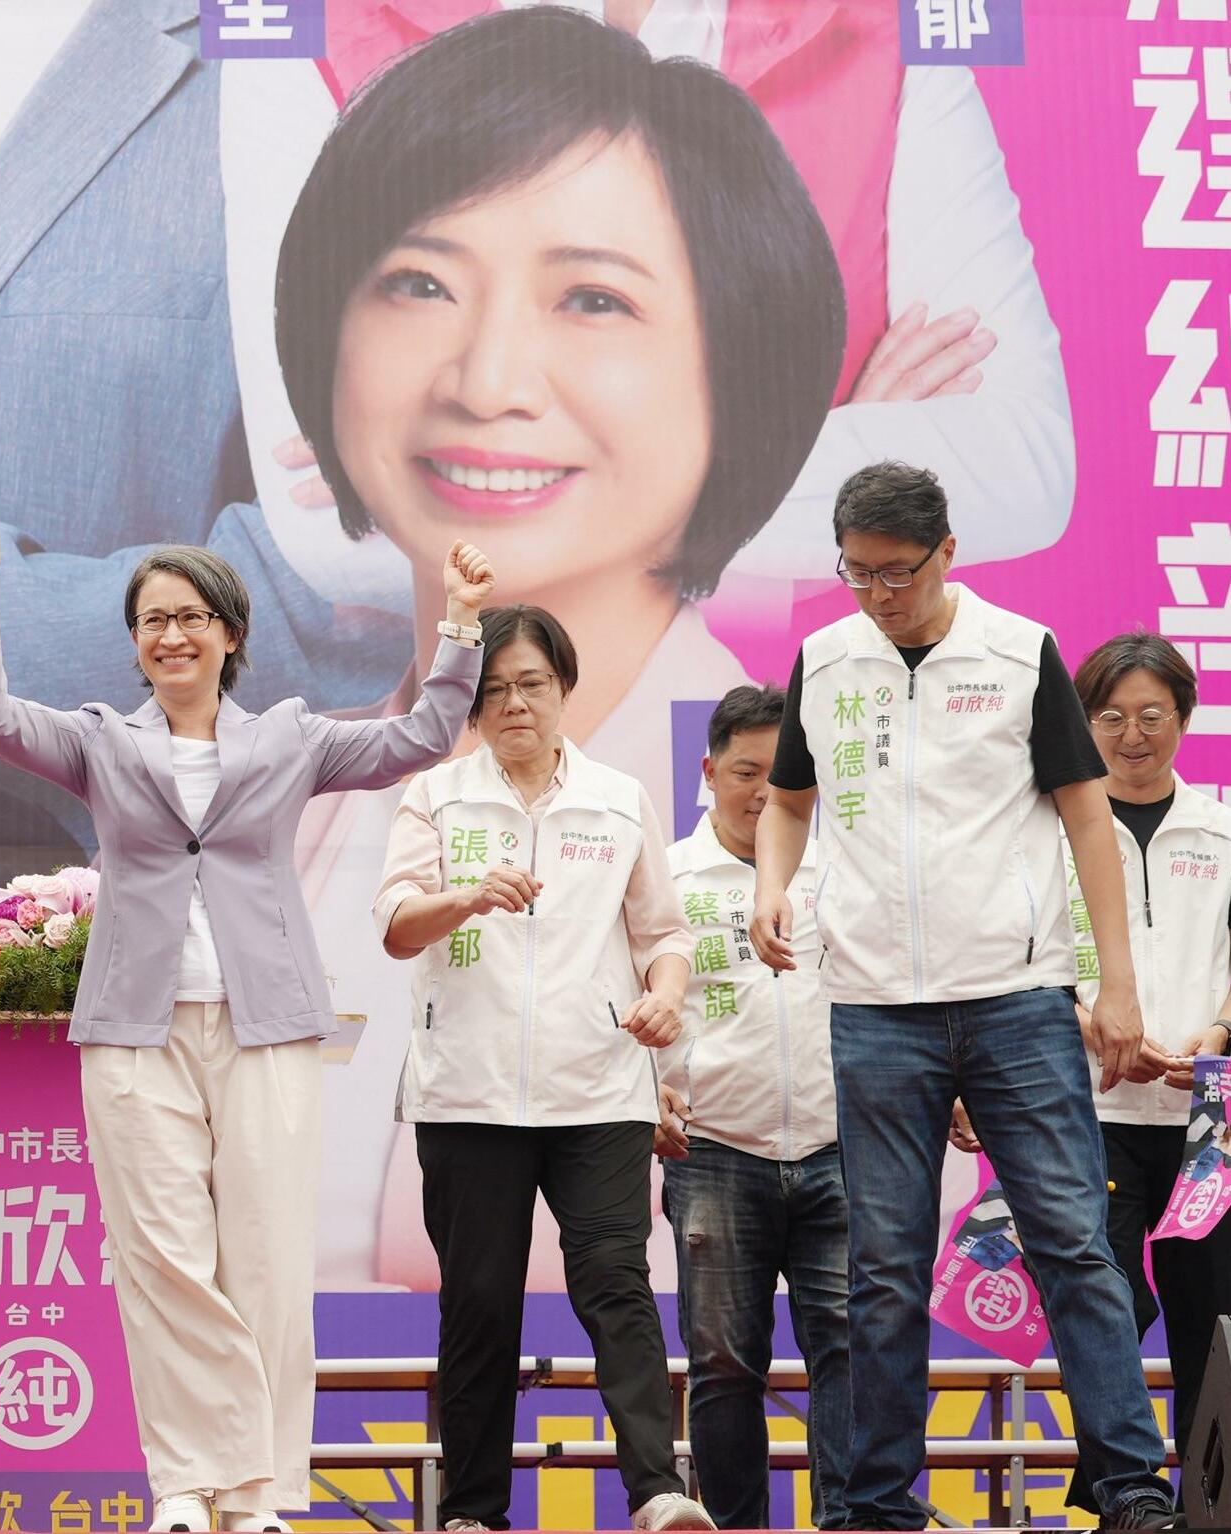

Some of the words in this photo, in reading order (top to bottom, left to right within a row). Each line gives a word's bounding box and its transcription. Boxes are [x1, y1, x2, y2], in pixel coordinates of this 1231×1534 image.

[946, 695, 1005, 713] 何欣純
[947, 683, 1006, 693] 台中市長候選人
[832, 690, 866, 831] 林德宇
[876, 714, 891, 769] 市議員
[560, 842, 616, 864] 何欣純
[561, 832, 617, 843] 台中市長候選人
[448, 827, 489, 968] 張郁
[730, 911, 753, 961] 市議員
[4, 1301, 66, 1327] 台中
[972, 1273, 1021, 1324] 純
[50, 1490, 144, 1533] 台中
